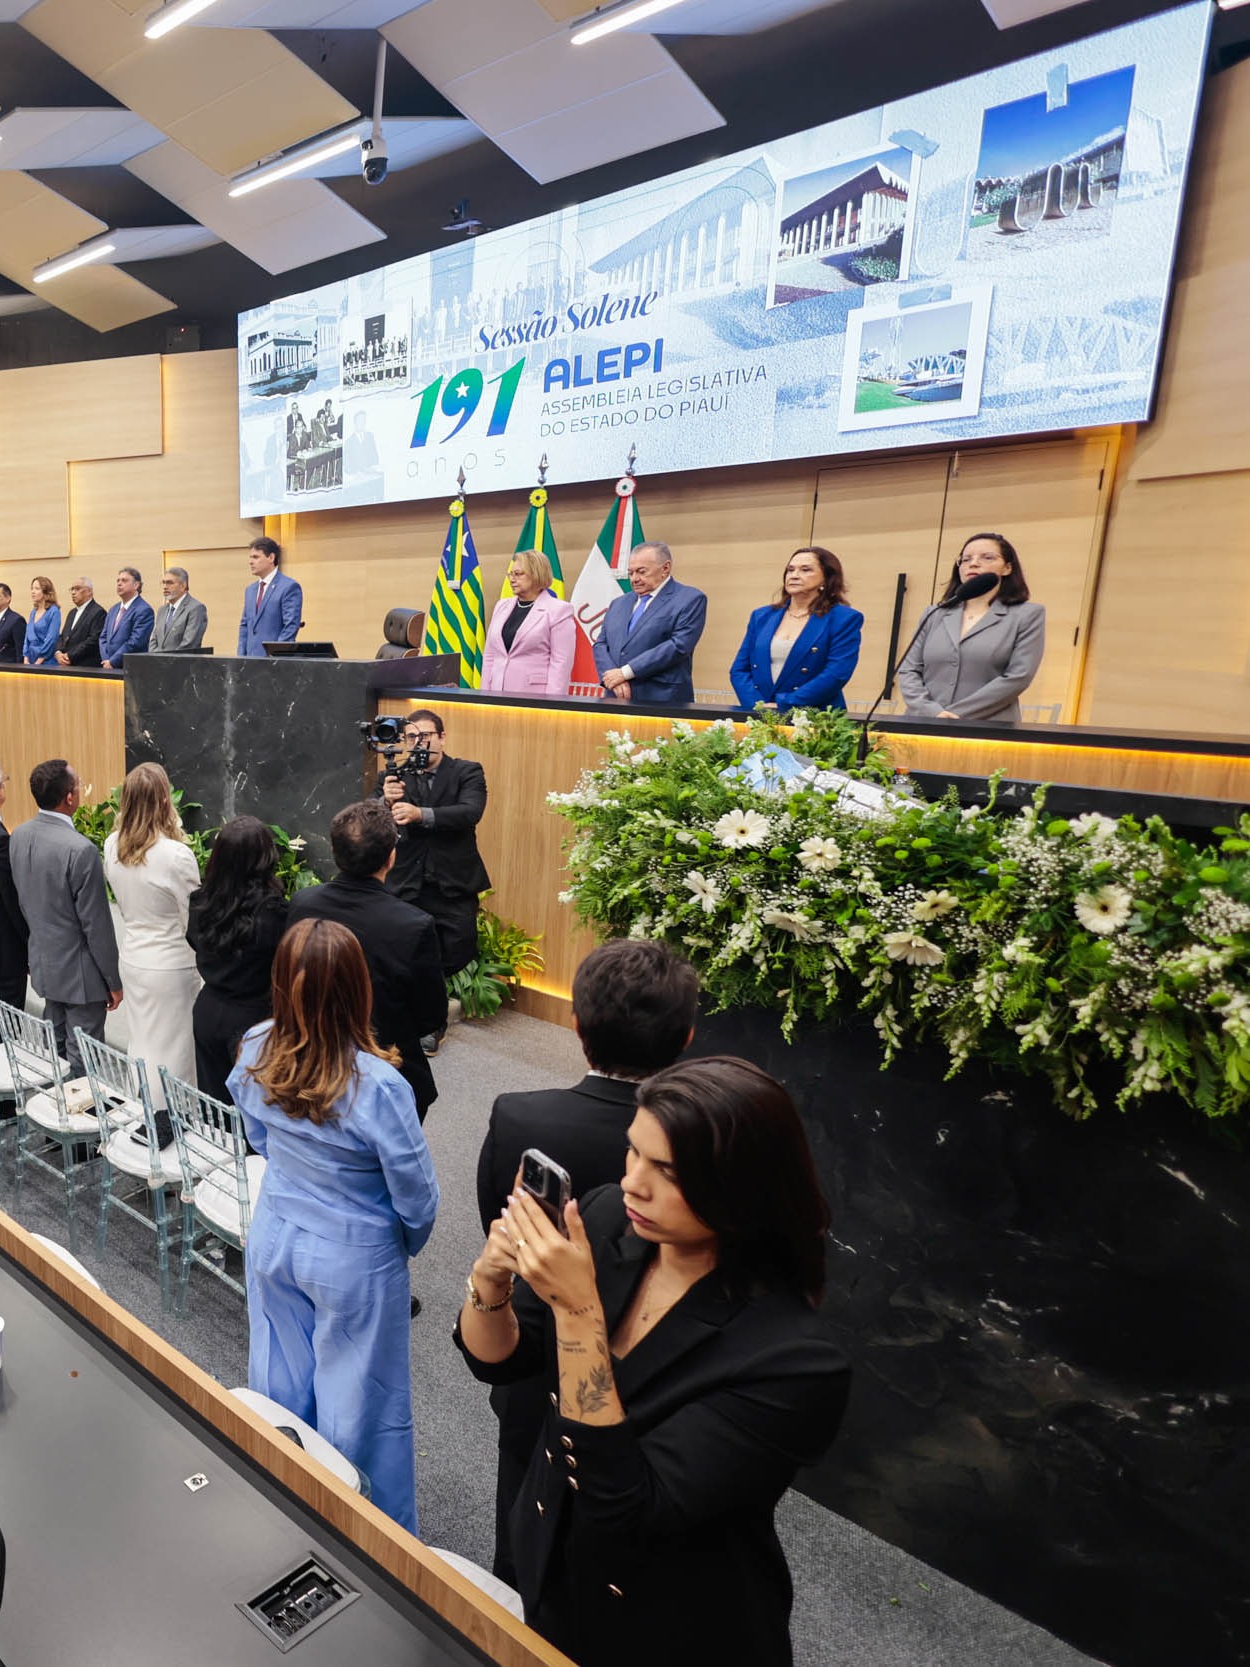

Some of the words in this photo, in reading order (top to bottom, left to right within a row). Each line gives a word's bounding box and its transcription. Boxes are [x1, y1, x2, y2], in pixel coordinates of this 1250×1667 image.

[475, 310, 557, 352] Sessão
[562, 291, 658, 334] Solene
[541, 387, 642, 416] ASSEMBLEIA
[648, 365, 767, 399] LEGISLATIVA
[543, 338, 664, 393] ALEPI
[410, 356, 526, 448] 191
[540, 421, 566, 437] DO
[570, 410, 639, 433] ESTADO
[644, 404, 674, 422] DO
[679, 392, 730, 416] PIAUÍ
[406, 448, 506, 478] anos
